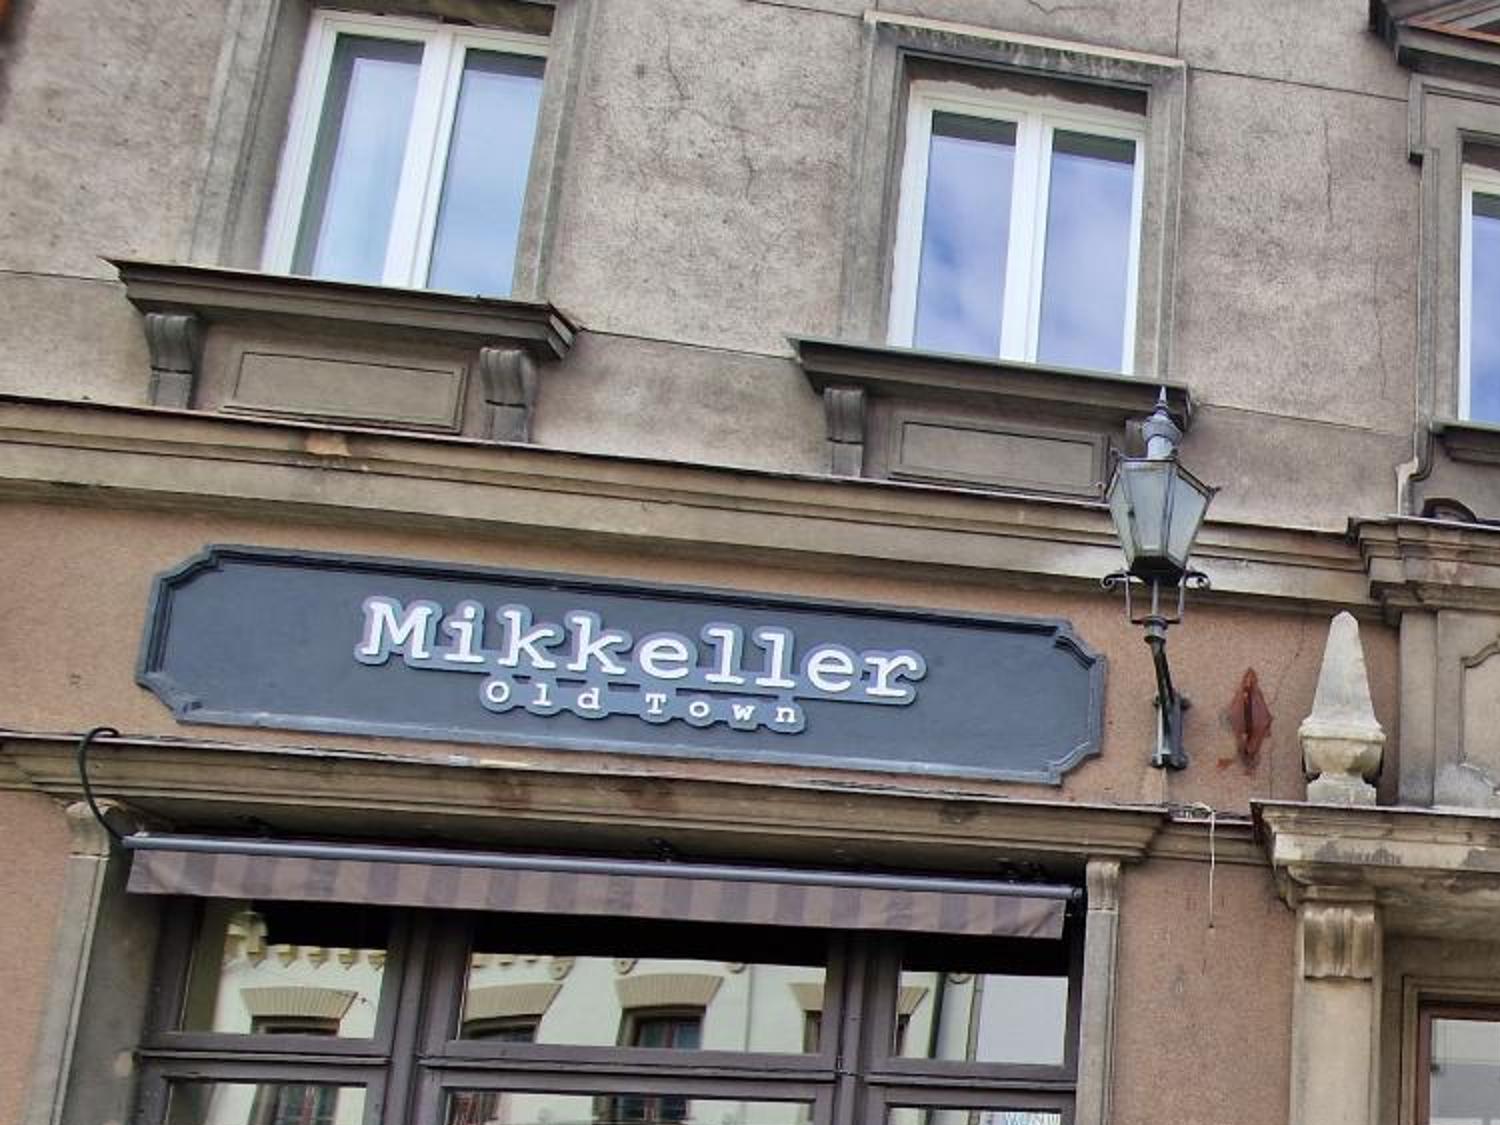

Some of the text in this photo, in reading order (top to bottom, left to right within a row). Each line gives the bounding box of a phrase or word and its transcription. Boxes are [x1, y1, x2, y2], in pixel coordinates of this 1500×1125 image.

[361, 602, 917, 697] Mikkeller
[486, 681, 796, 723] Old Town
